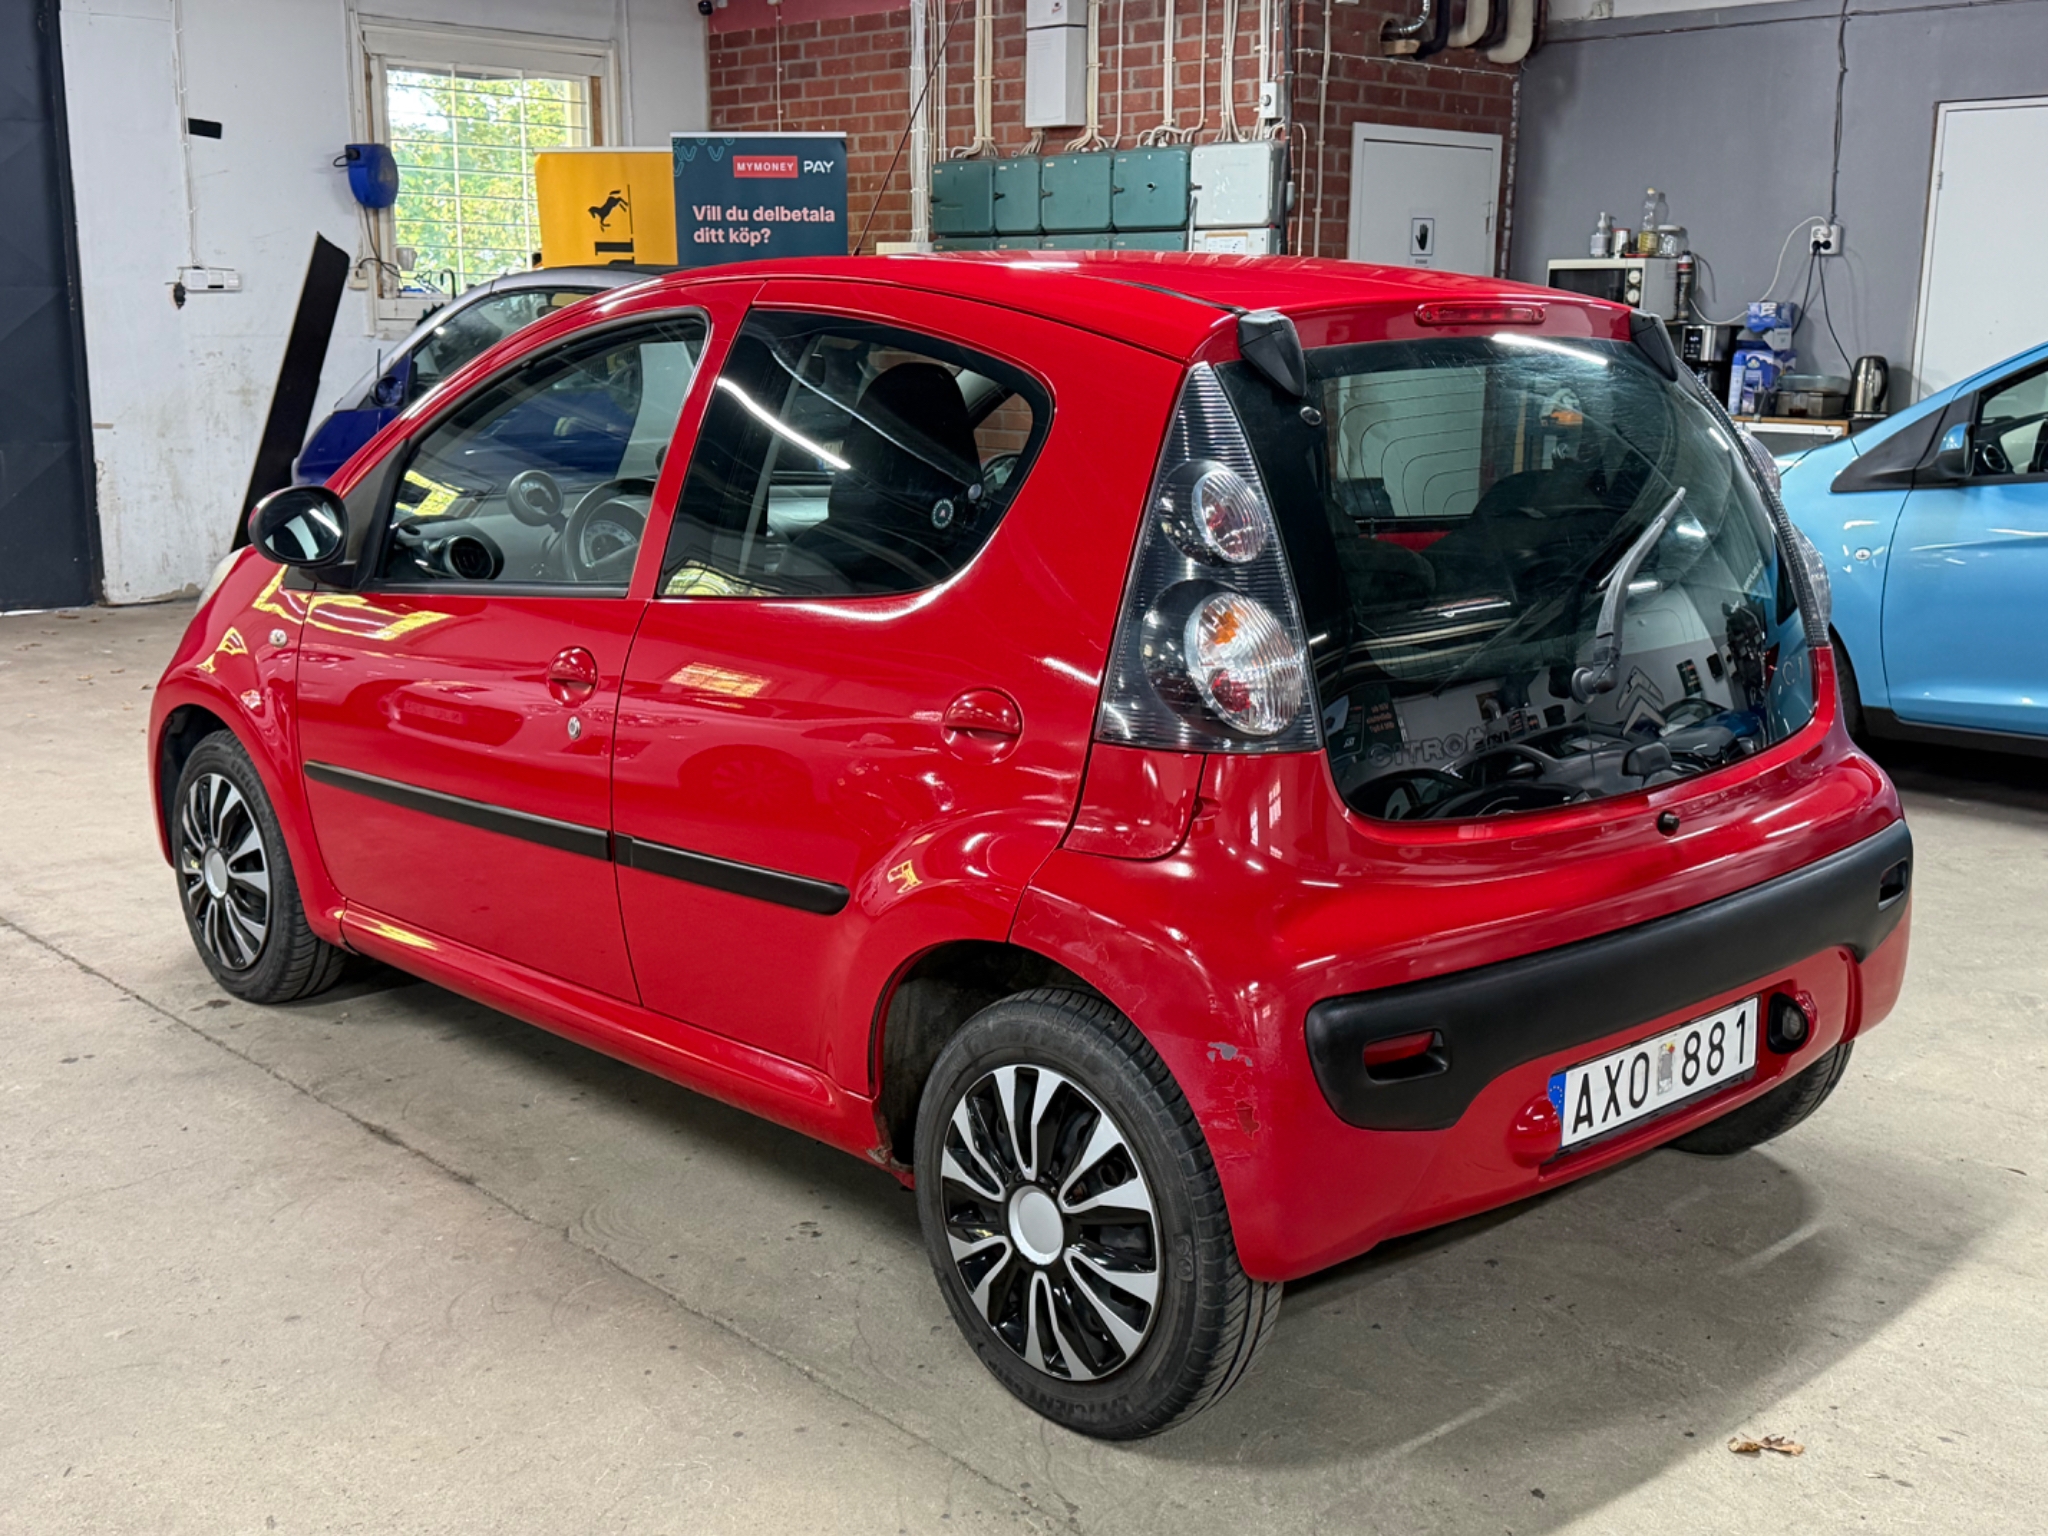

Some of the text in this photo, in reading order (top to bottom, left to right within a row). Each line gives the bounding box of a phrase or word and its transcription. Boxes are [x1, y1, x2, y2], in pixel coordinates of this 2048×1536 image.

[736, 160, 835, 174] MYMONEY PAY
[692, 205, 836, 223] Vill du delbetala
[693, 227, 772, 247] ditt köp?
[1571, 1010, 1748, 1135] AXO 881
